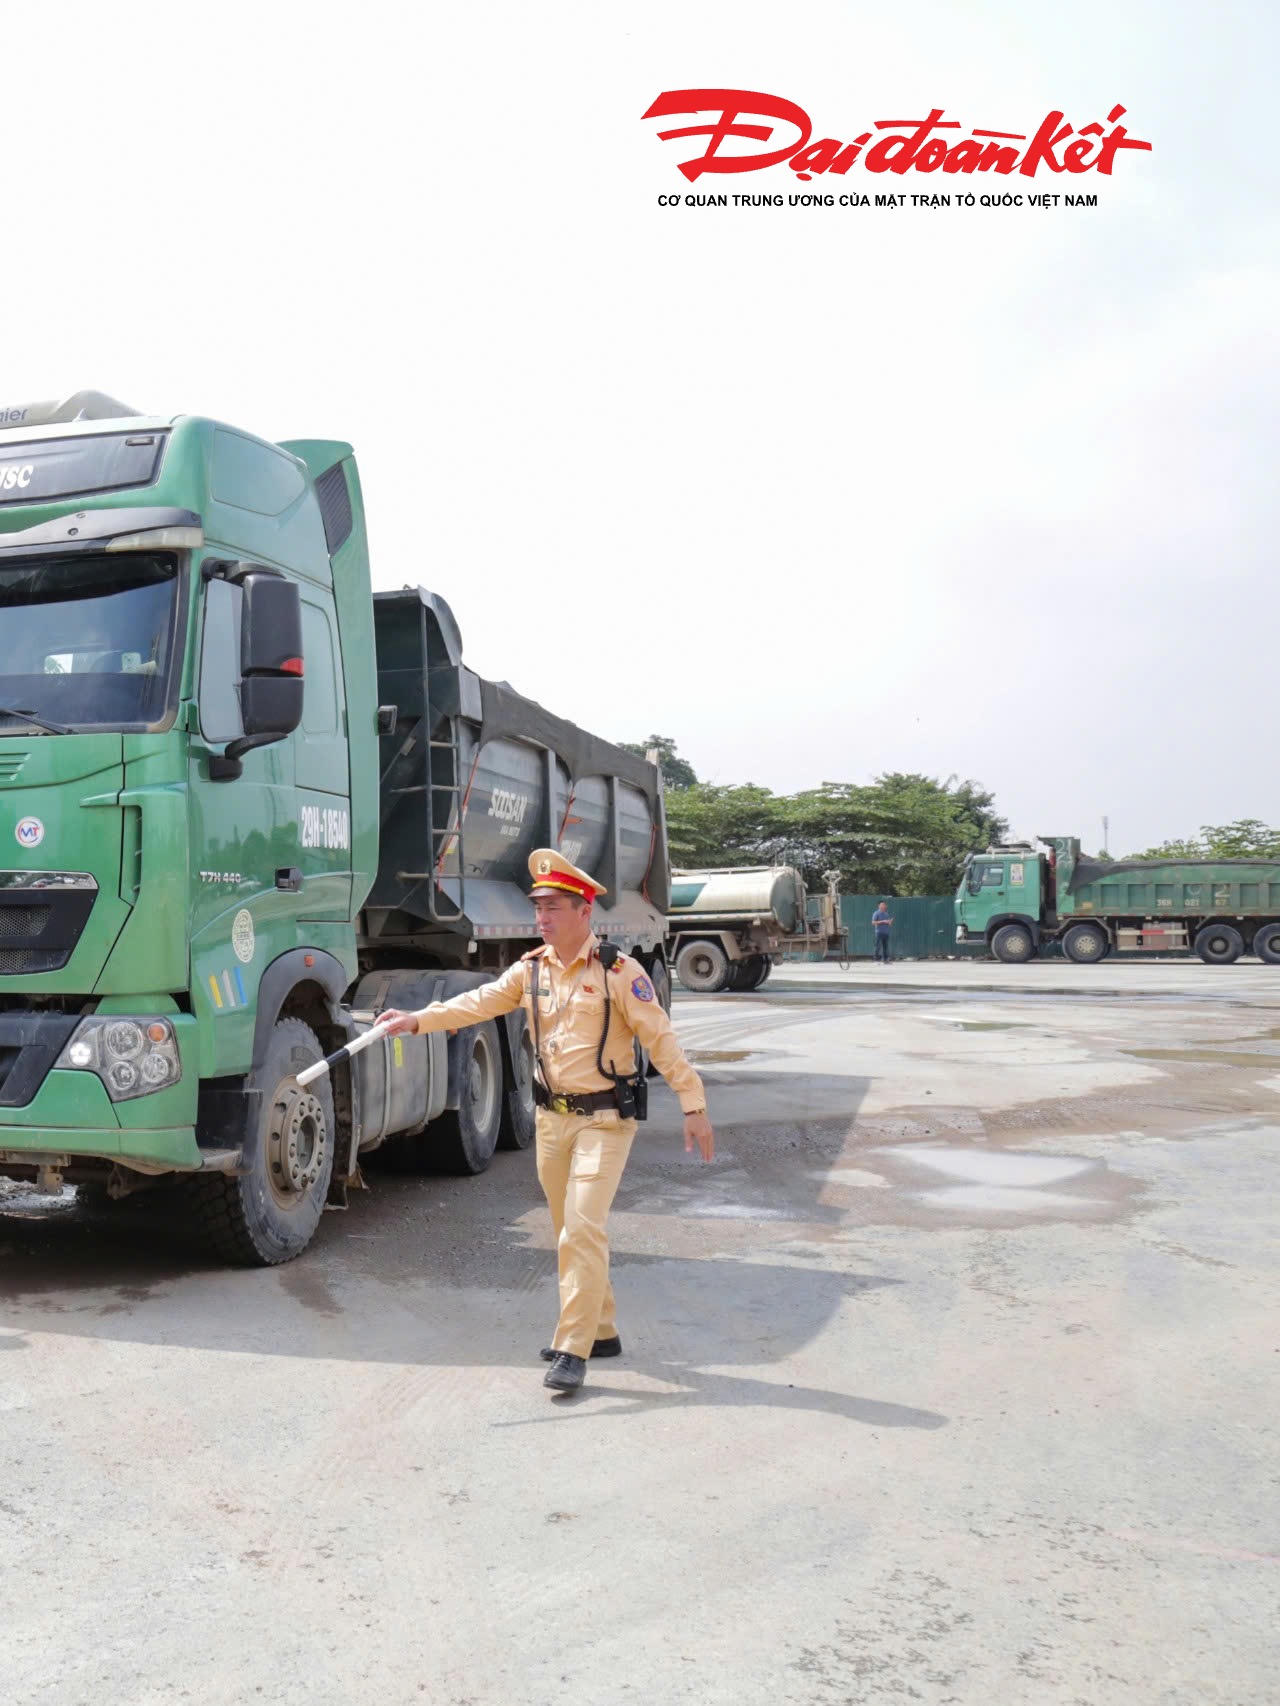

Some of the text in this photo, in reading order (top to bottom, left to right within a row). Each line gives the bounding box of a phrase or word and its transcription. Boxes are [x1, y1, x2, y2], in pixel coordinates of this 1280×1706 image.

[301, 805, 349, 850] 29H-18540
[199, 870, 242, 884] T7H 440
